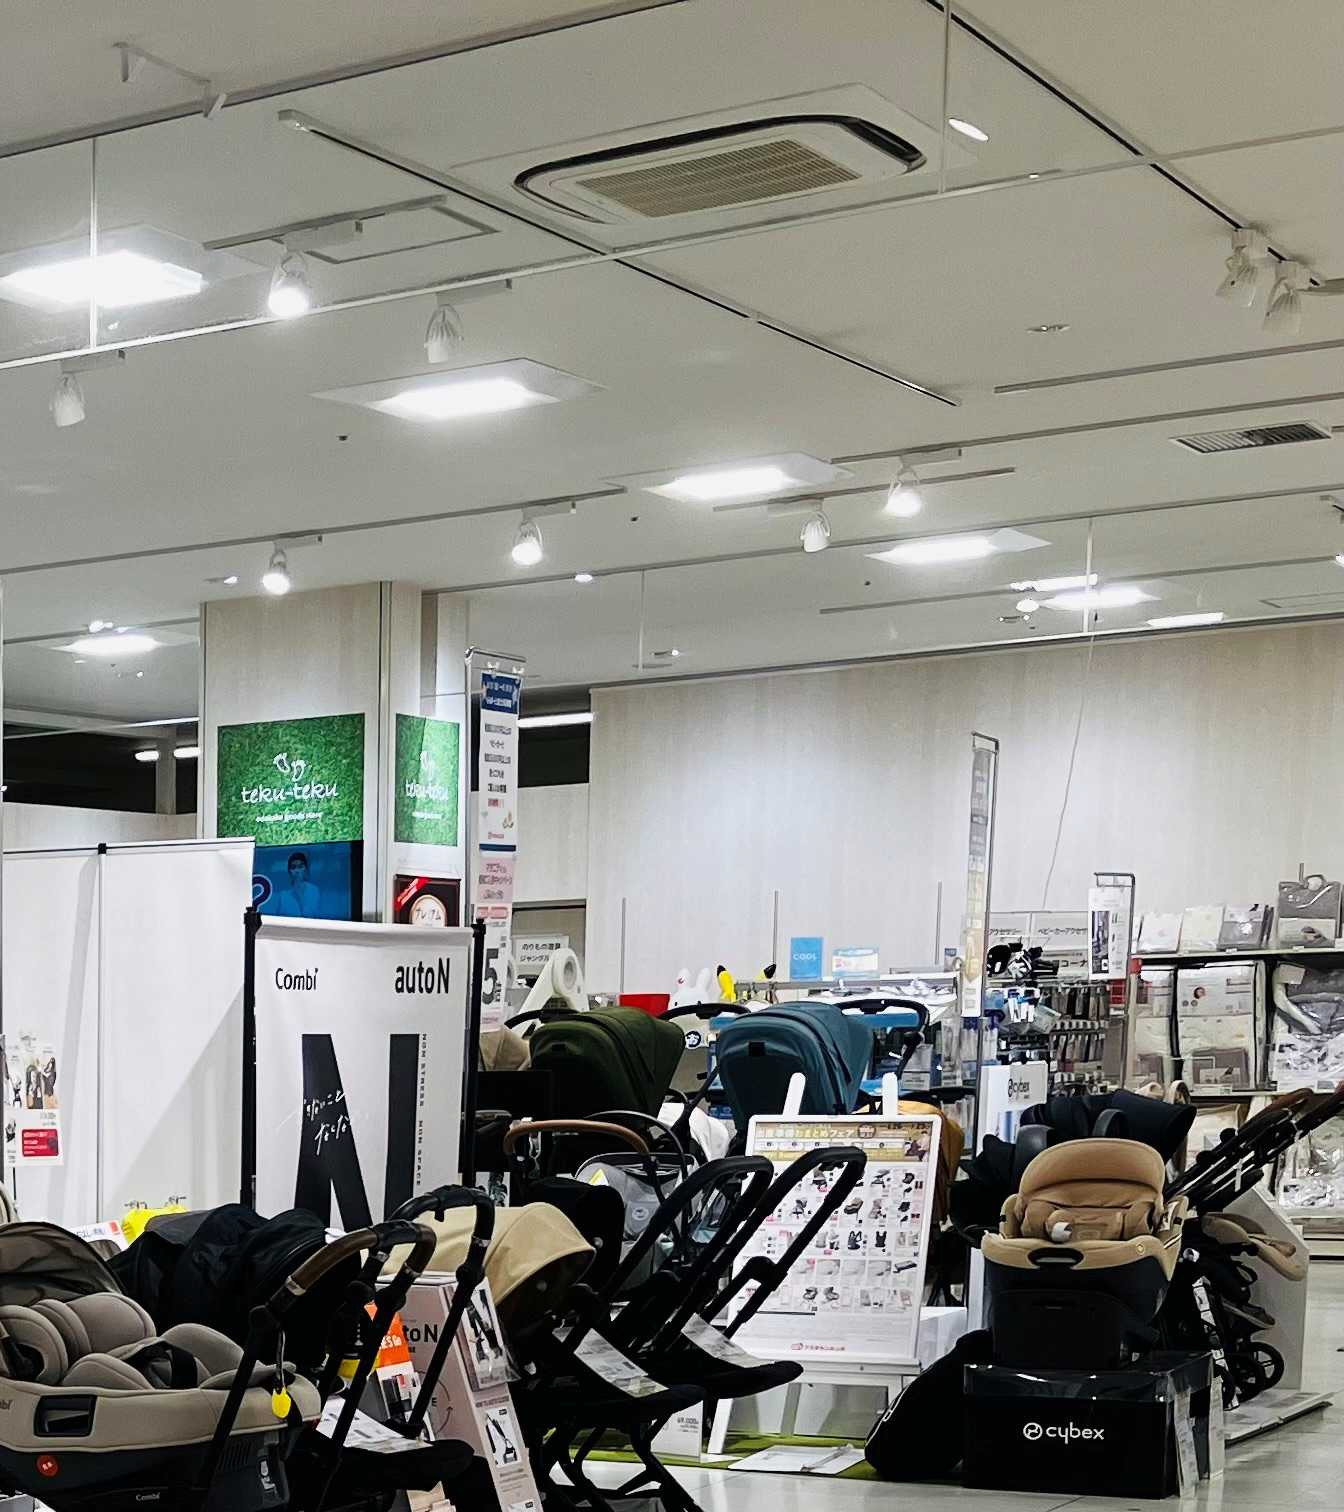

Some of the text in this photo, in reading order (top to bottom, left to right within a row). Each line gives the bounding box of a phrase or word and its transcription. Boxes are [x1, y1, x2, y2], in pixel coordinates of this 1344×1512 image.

[241, 782, 338, 803] teku-teku
[275, 968, 318, 991] Combi
[1046, 1422, 1105, 1444] cybex
